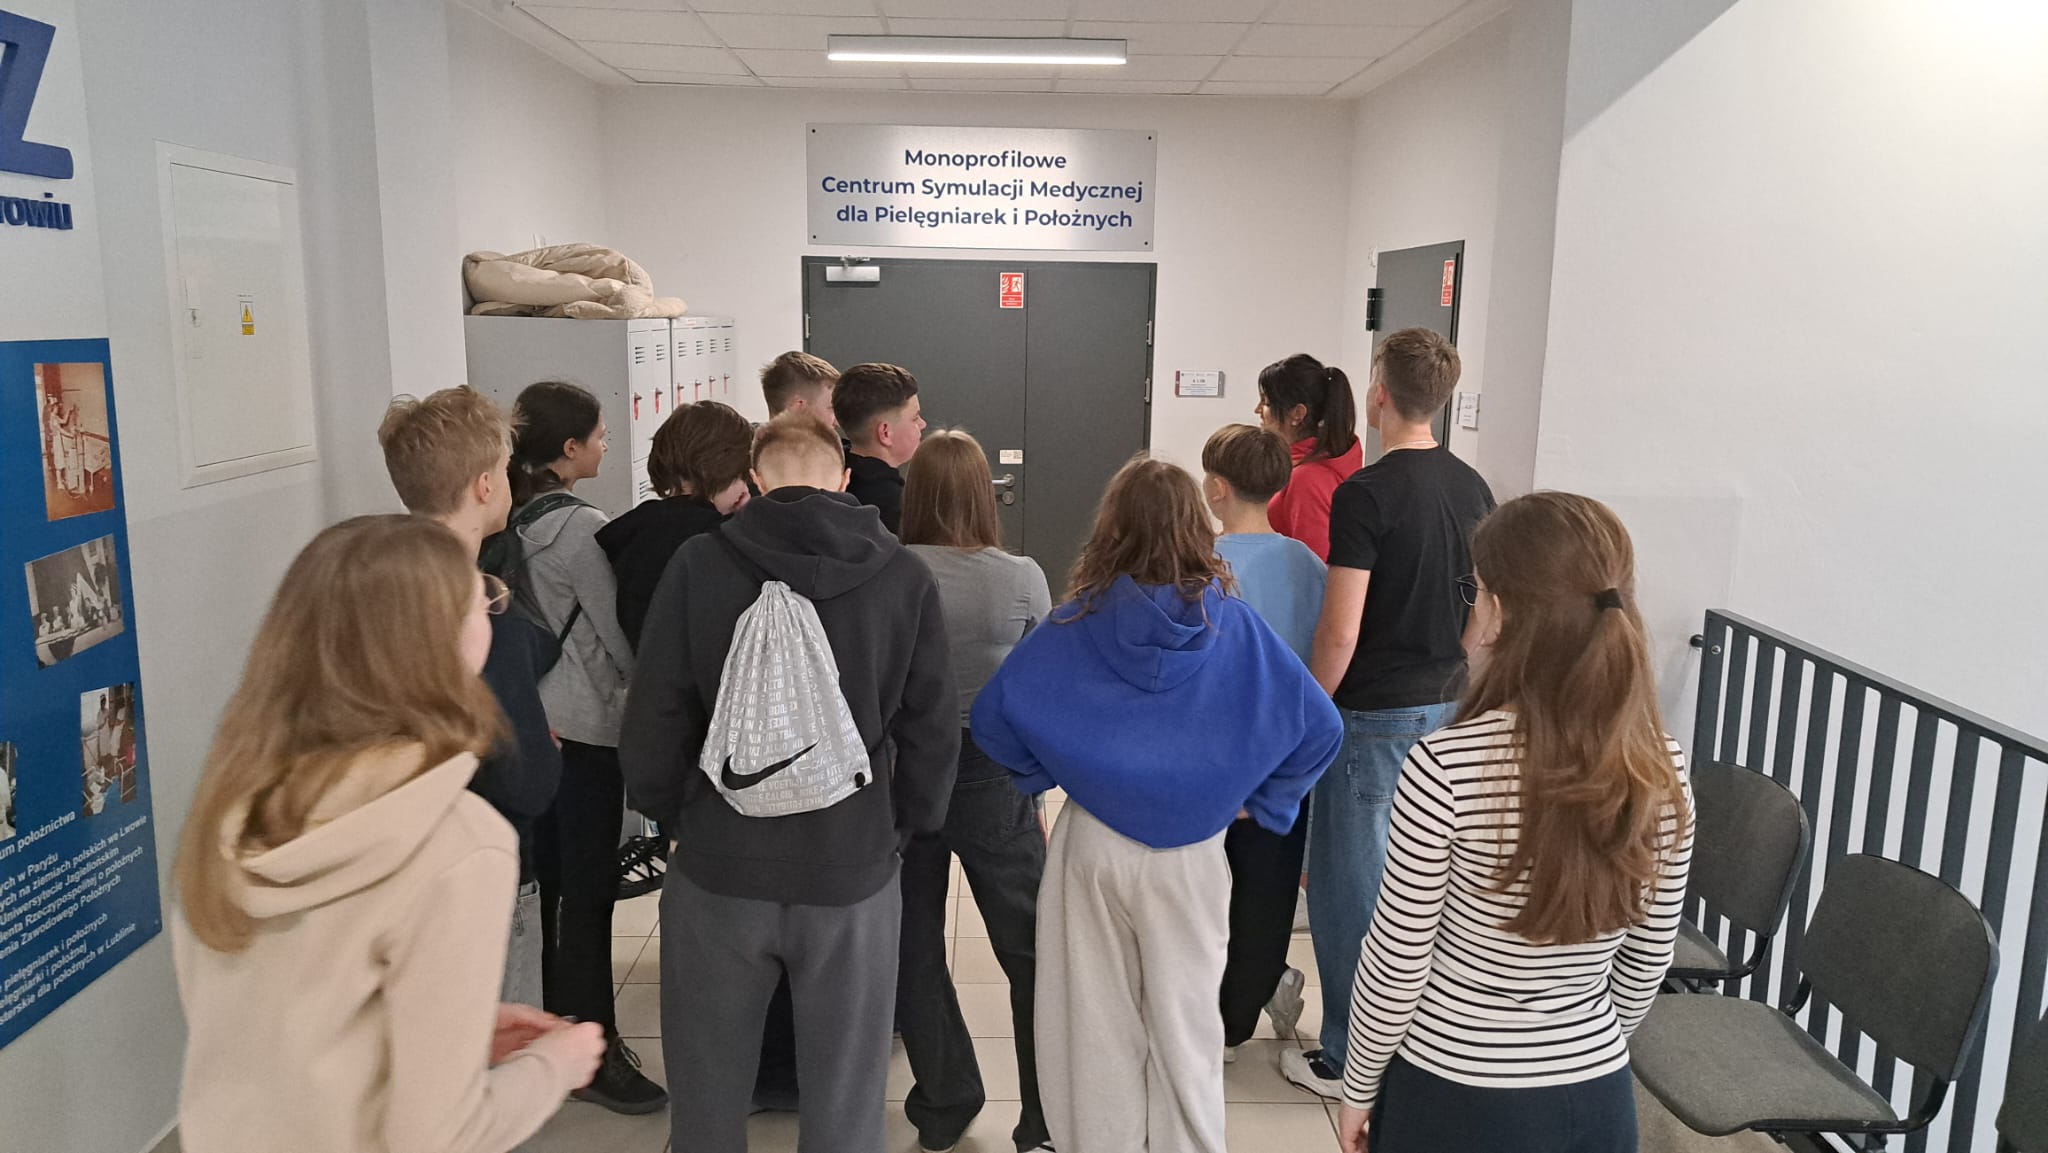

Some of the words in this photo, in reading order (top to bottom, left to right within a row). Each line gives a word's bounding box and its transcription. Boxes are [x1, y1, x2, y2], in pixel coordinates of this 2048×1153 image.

[905, 149, 1067, 171] Monoprofilowe
[821, 176, 916, 195] Centrum
[921, 178, 1024, 200] Symulacji
[1030, 180, 1143, 203] Medycznej
[836, 205, 868, 223] dla
[875, 206, 1007, 229] Pielęgniarek
[1012, 208, 1019, 225] i
[1025, 208, 1132, 231] Położnych
[17, 811, 76, 852] położnictwa
[17, 871, 26, 882] w
[27, 852, 59, 877] Paryżu
[19, 885, 31, 898] na
[73, 838, 106, 868] polskich
[21, 903, 79, 946] Zawodowego
